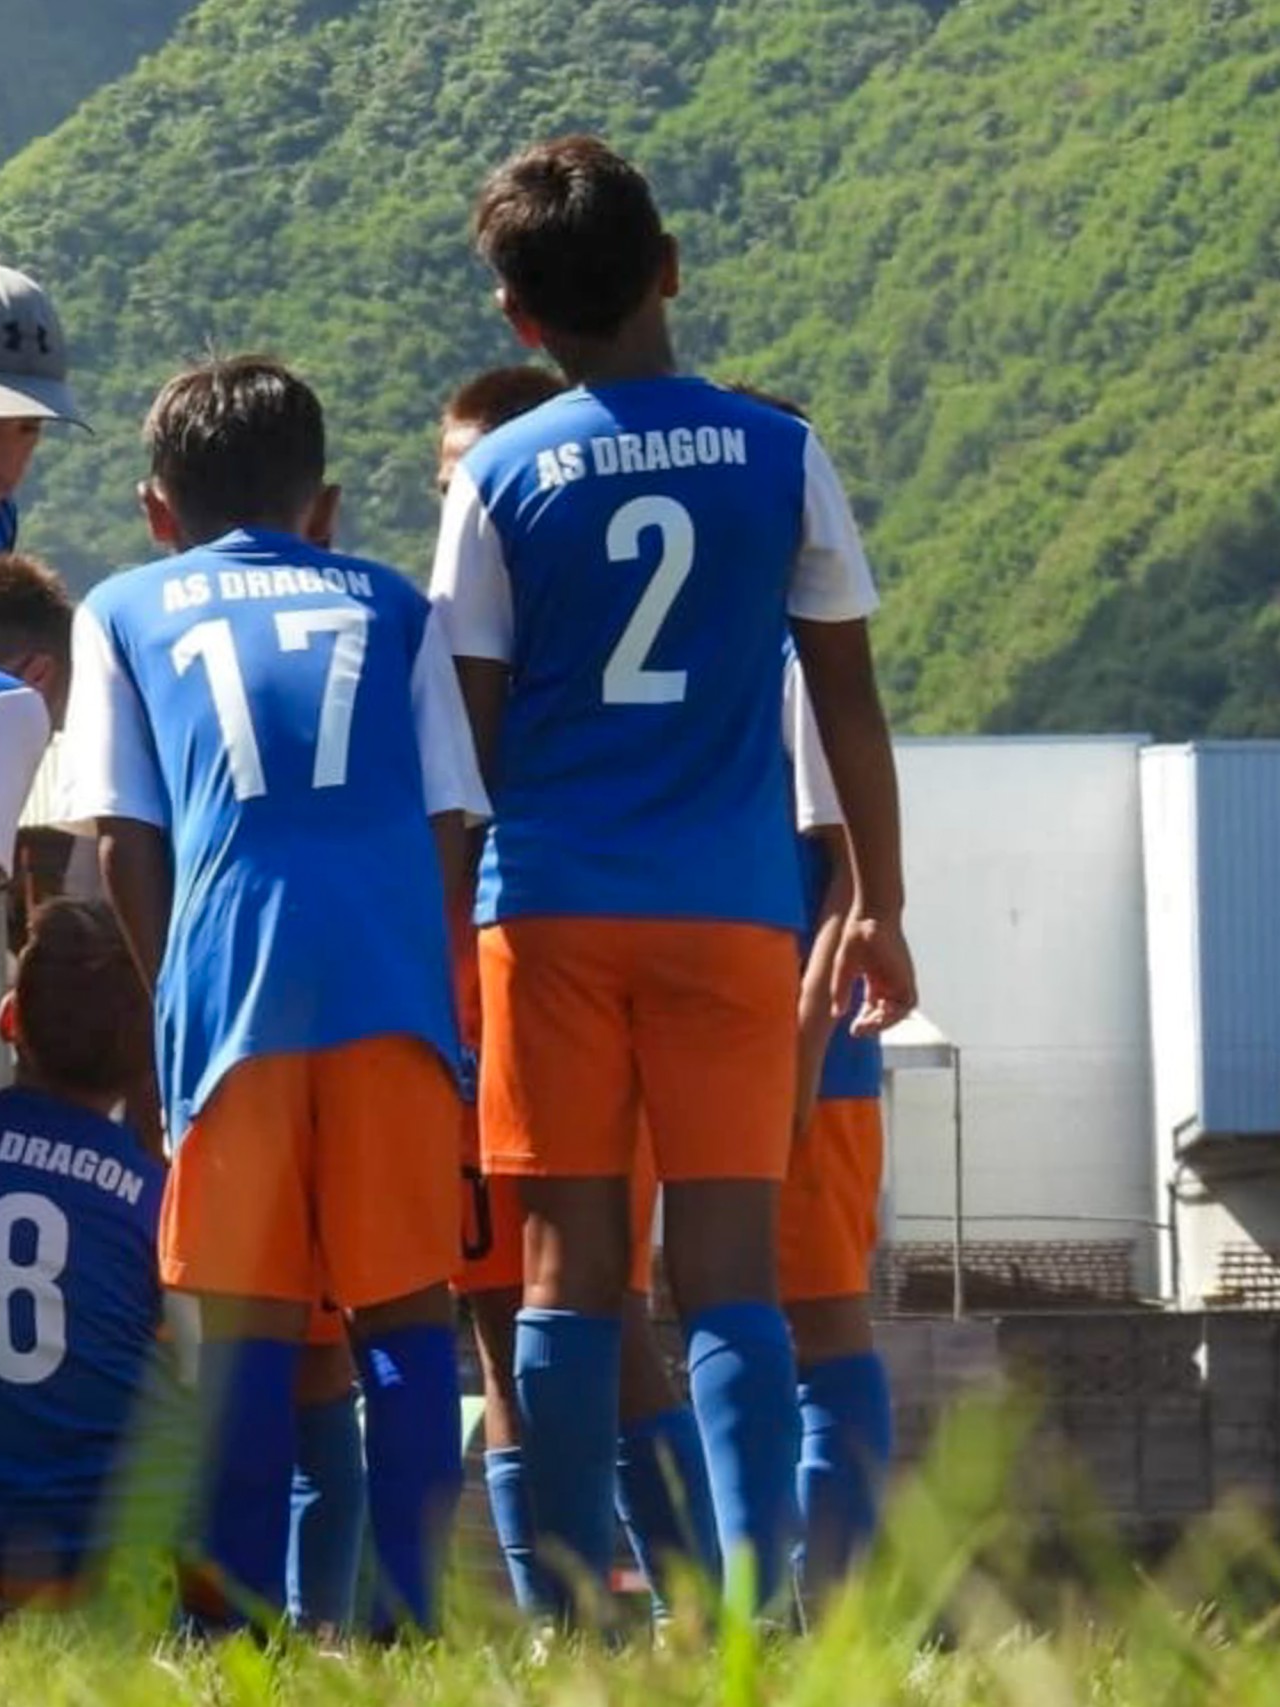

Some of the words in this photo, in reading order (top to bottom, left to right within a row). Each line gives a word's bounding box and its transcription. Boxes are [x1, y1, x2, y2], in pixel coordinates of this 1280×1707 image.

[535, 442, 586, 491] AS
[591, 426, 747, 476] DRAGON
[163, 573, 212, 613] AS
[219, 566, 373, 599] DRAGON
[602, 494, 695, 705] 2
[172, 607, 377, 801] 17
